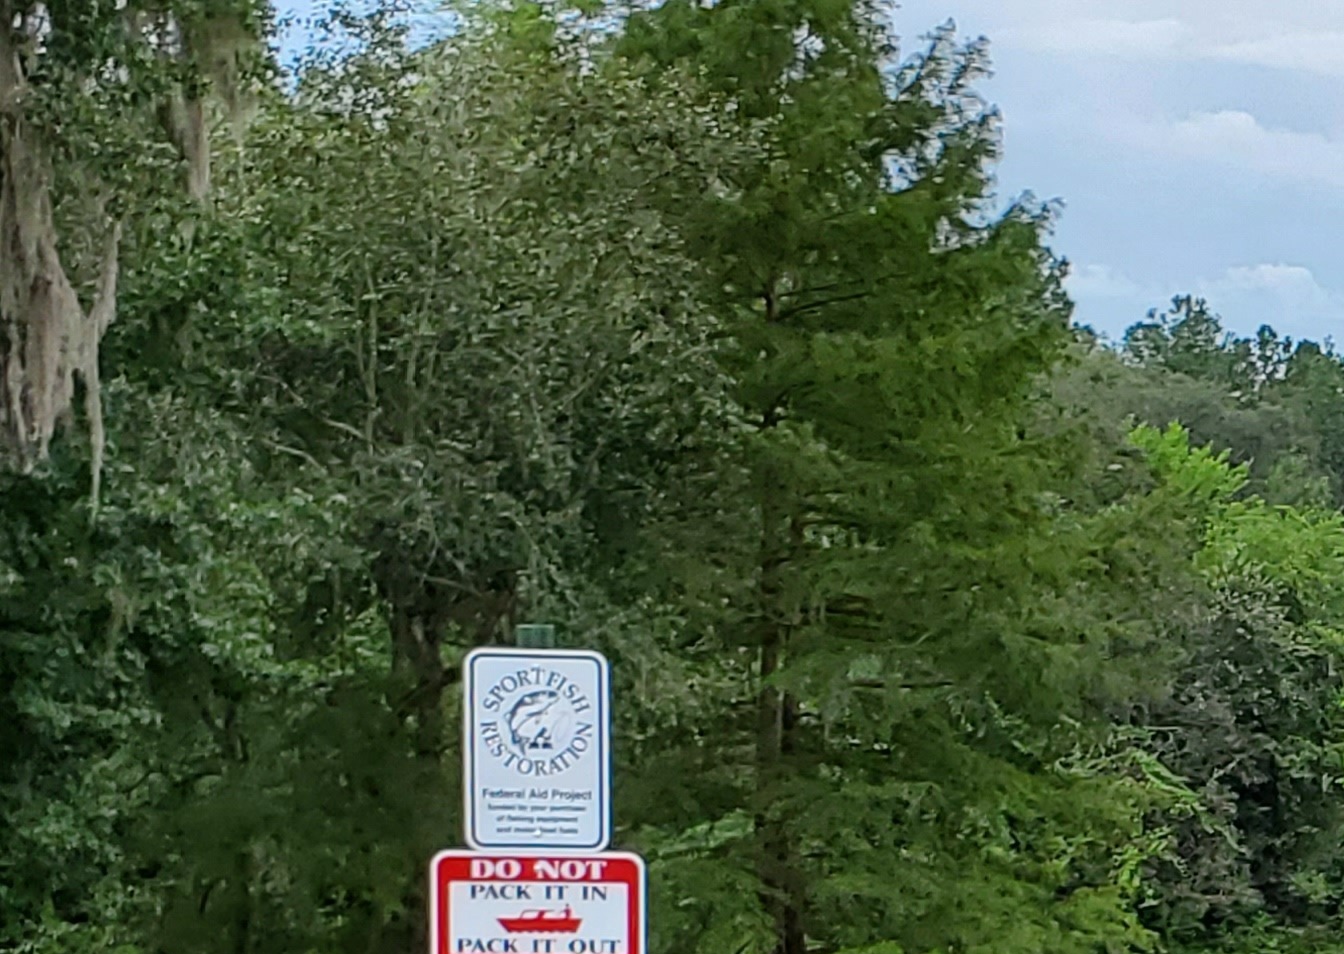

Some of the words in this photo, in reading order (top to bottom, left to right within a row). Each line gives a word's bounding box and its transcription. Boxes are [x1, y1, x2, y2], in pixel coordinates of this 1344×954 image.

[480, 720, 593, 777] RESTORATION
[482, 788, 525, 800] Federal
[528, 789, 549, 800] Aid
[551, 789, 593, 803] Project
[470, 859, 522, 880] DO
[533, 859, 607, 880] NOT
[470, 884, 531, 900] PACK
[545, 885, 568, 900] IT
[582, 885, 608, 901] IN
[457, 938, 518, 954] PACK
[532, 938, 557, 954] IT
[568, 938, 622, 954] OUT
